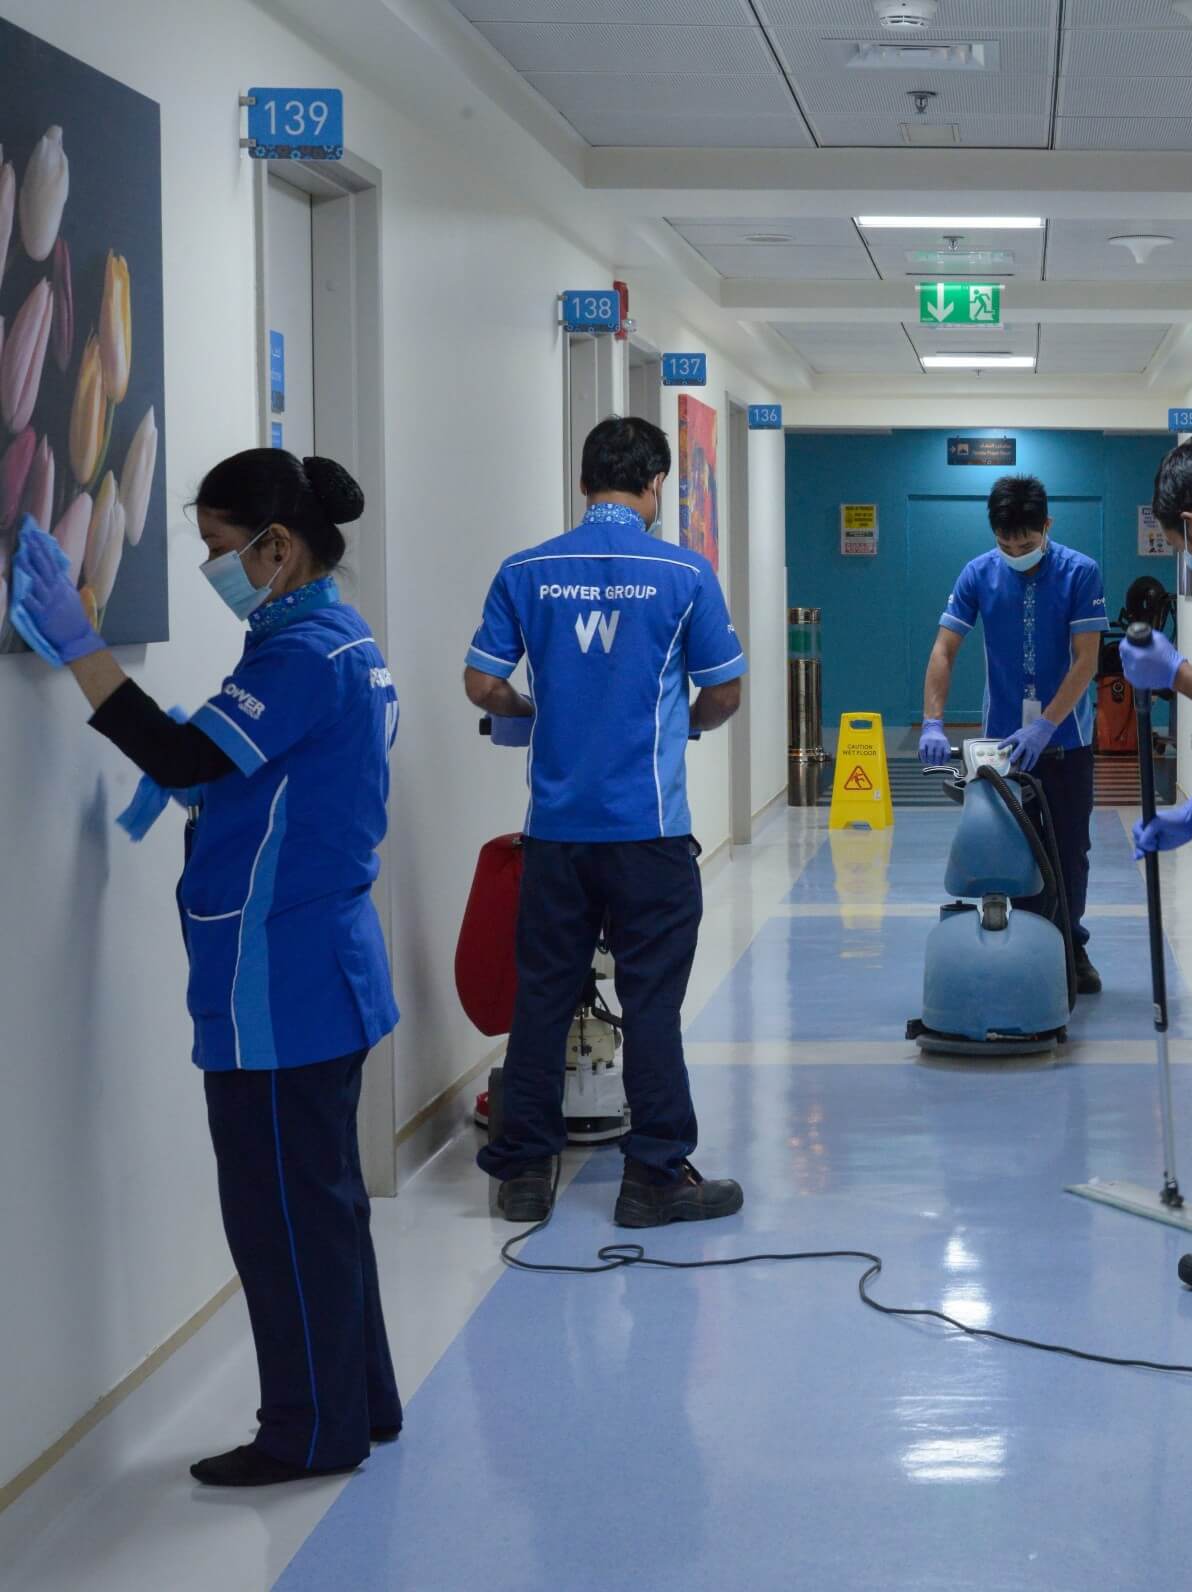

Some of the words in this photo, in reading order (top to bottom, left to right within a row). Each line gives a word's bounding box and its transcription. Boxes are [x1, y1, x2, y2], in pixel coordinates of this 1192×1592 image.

[263, 99, 328, 137] 139
[571, 296, 613, 320] 138
[669, 357, 702, 376] 137
[753, 408, 779, 423] 136
[539, 584, 601, 600] POWER
[604, 584, 657, 600] GROUP
[223, 683, 267, 715] OWER
